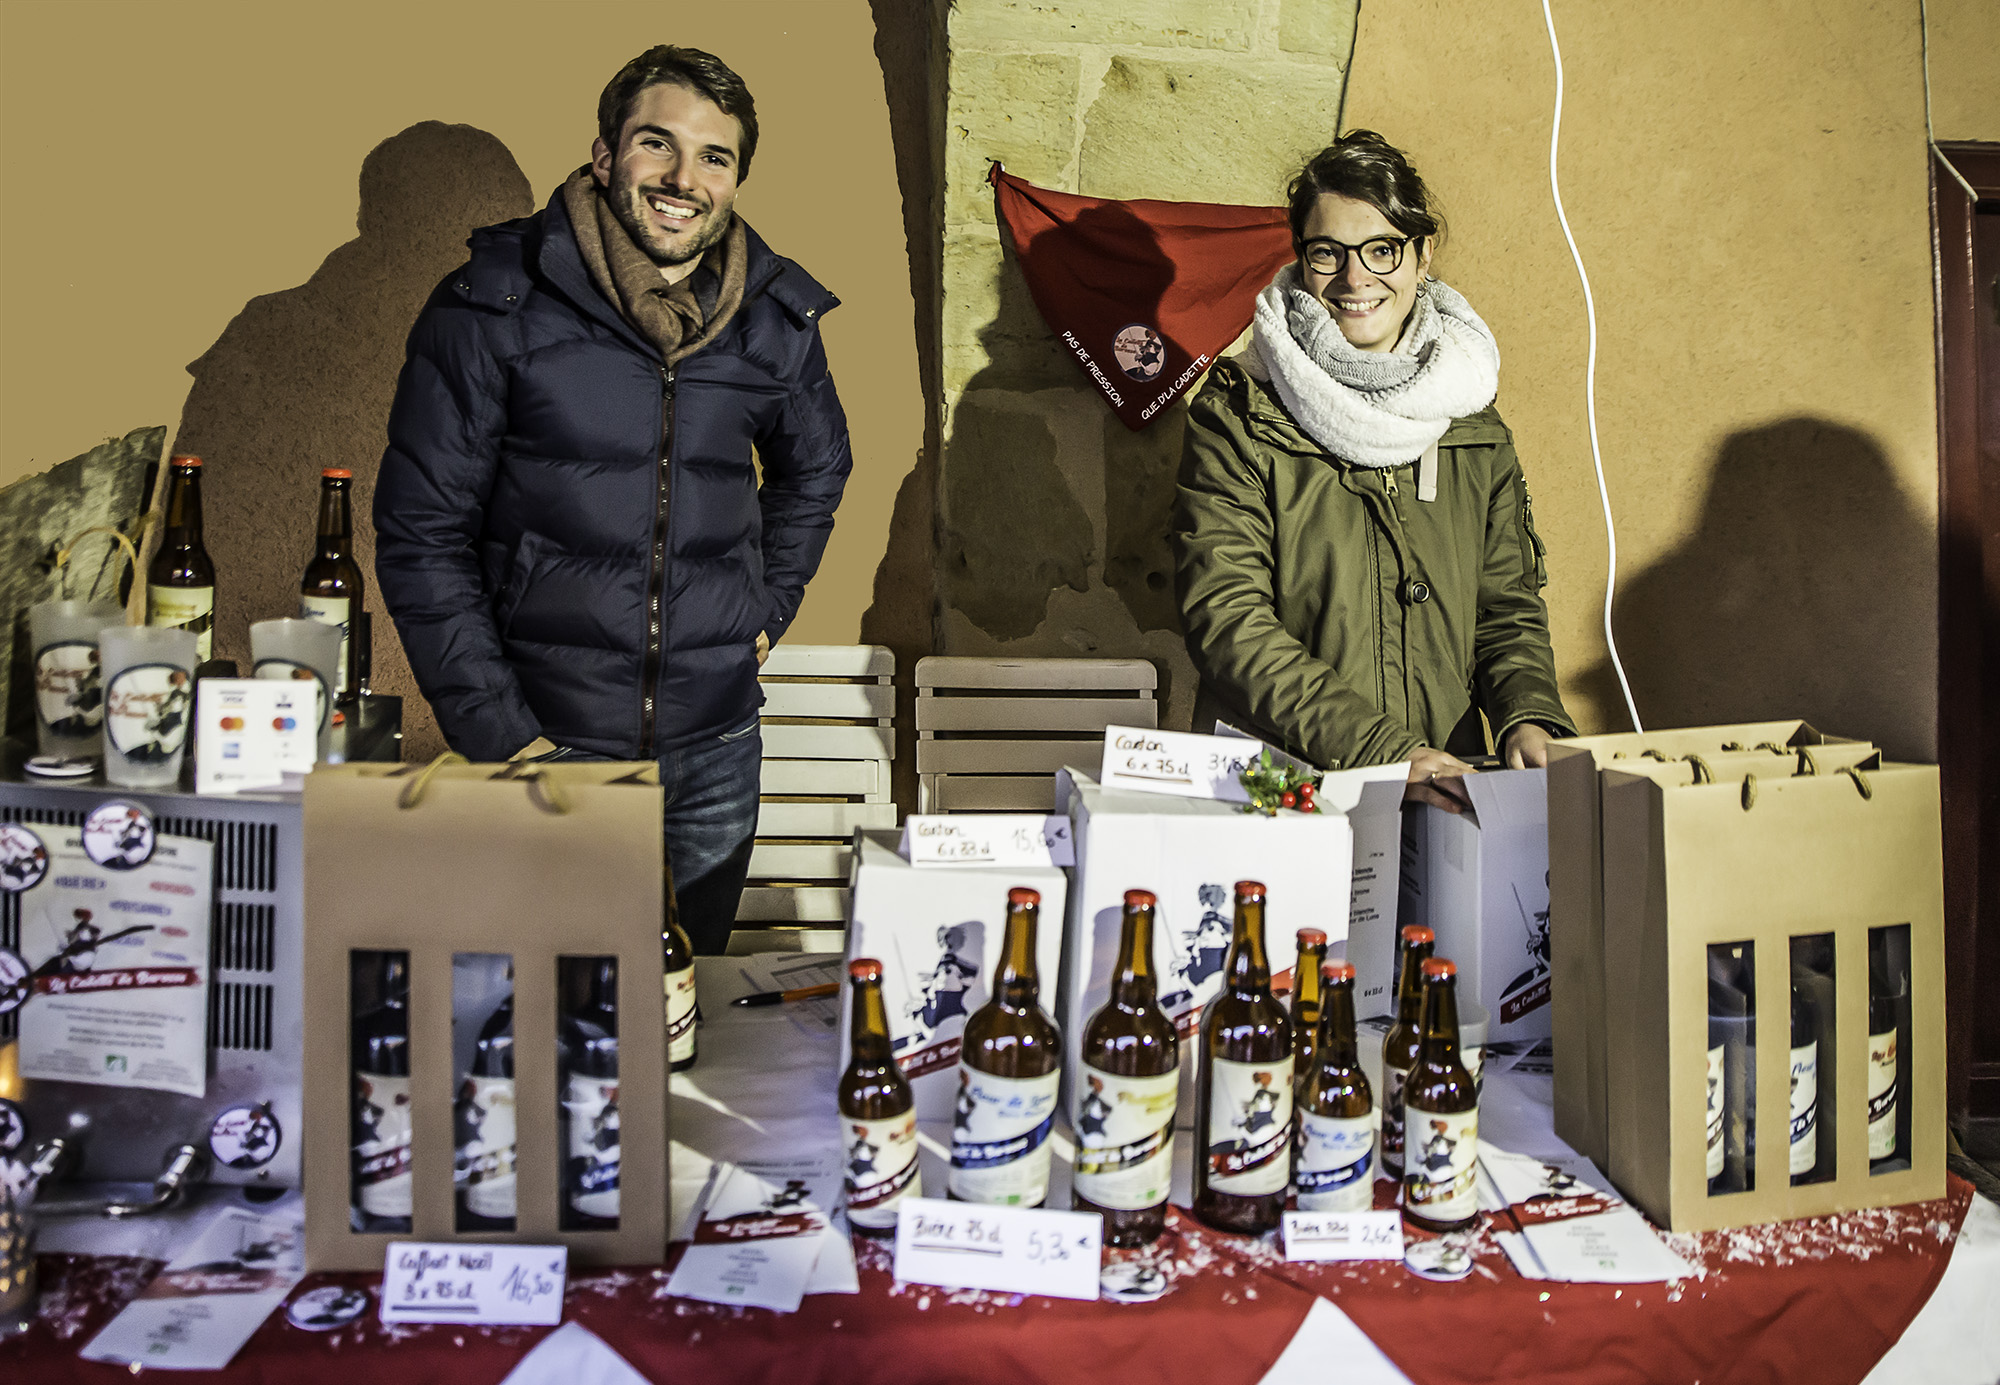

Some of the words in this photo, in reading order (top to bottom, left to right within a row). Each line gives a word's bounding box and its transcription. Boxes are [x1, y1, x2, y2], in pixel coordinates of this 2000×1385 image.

[1062, 330, 1080, 349] PAS
[1076, 347, 1090, 363] DE
[1086, 360, 1125, 408] PRESSION
[1141, 401, 1161, 421] QUE
[1159, 386, 1177, 405] D'LA
[1174, 353, 1211, 390] CADETTE
[1115, 735, 1166, 753] Carton
[1127, 758, 1136, 769] 6
[1155, 759, 1174, 774] 75
[1177, 763, 1190, 776] cl
[918, 822, 960, 837] Carton
[937, 842, 947, 855] 6
[960, 842, 976, 855] 33
[966, 1219, 985, 1241] 75
